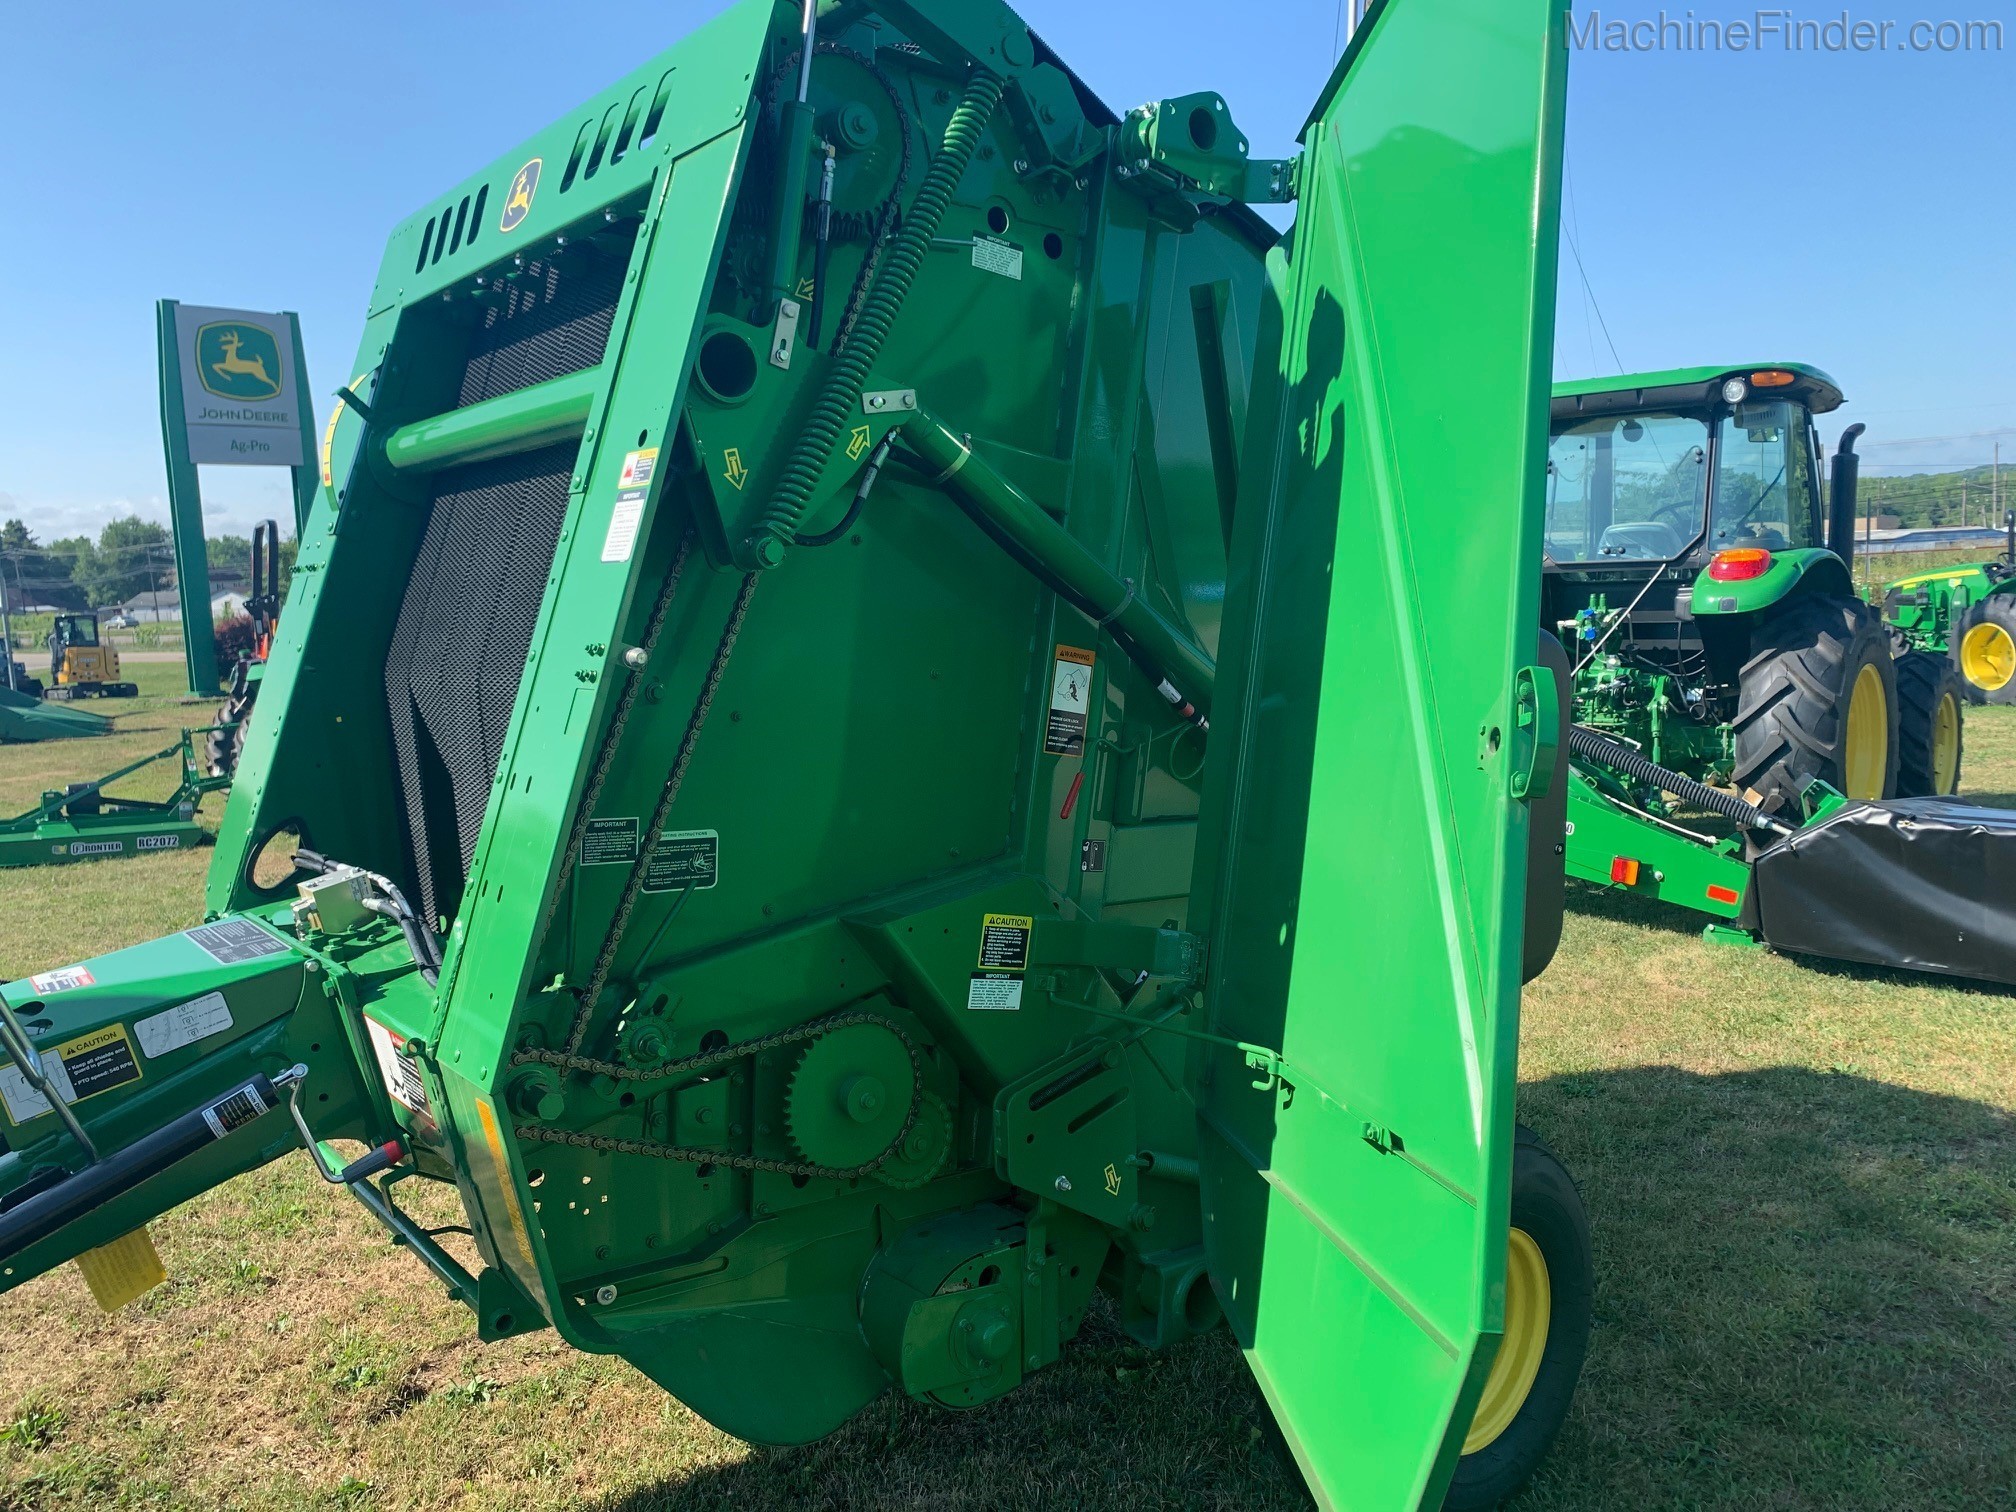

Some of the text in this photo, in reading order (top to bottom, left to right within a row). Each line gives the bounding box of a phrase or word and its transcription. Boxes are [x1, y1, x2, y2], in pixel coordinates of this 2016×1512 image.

[986, 235, 1010, 246] IMPORTANT
[198, 407, 289, 423] JOHN DEERE
[230, 439, 270, 454] Ag-Pro
[1064, 650, 1090, 661] WARNING
[72, 836, 178, 855] FRONTIER RC2072
[995, 917, 1028, 927] CAUTION
[76, 1031, 117, 1051] CAUTION
[71, 1061, 87, 1071] Keep
[94, 1051, 115, 1062] shields
[115, 1046, 126, 1054] and
[77, 1077, 90, 1086] PTO
[109, 1066, 120, 1074] 540
[120, 1061, 133, 1070] RPM
